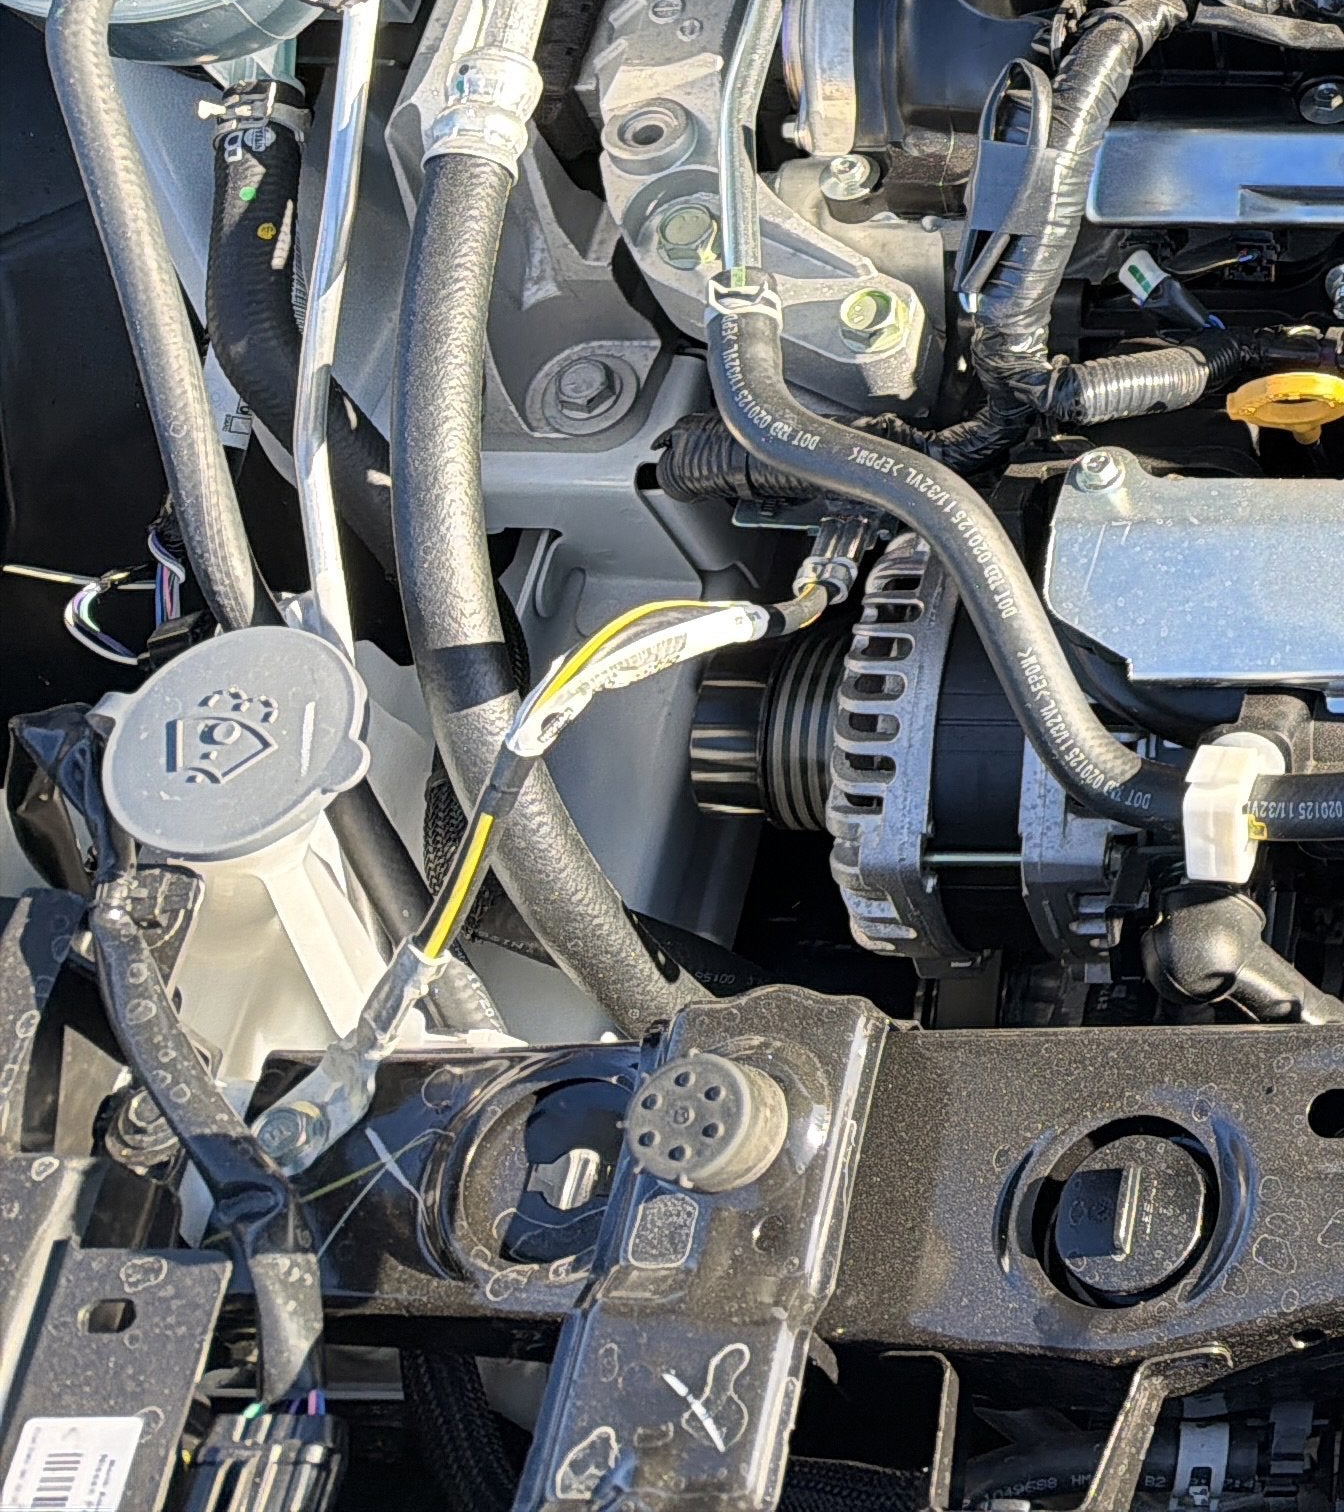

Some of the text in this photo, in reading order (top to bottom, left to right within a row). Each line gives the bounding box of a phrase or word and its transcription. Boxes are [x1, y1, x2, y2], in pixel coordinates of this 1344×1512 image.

[738, 389, 771, 429] 020125
[792, 430, 821, 452] DOT
[950, 509, 993, 564] 020125
[994, 590, 1018, 619] DOT
[1066, 747, 1106, 789] 020125
[1125, 791, 1151, 810] DOT
[1298, 799, 1344, 820] 020125
